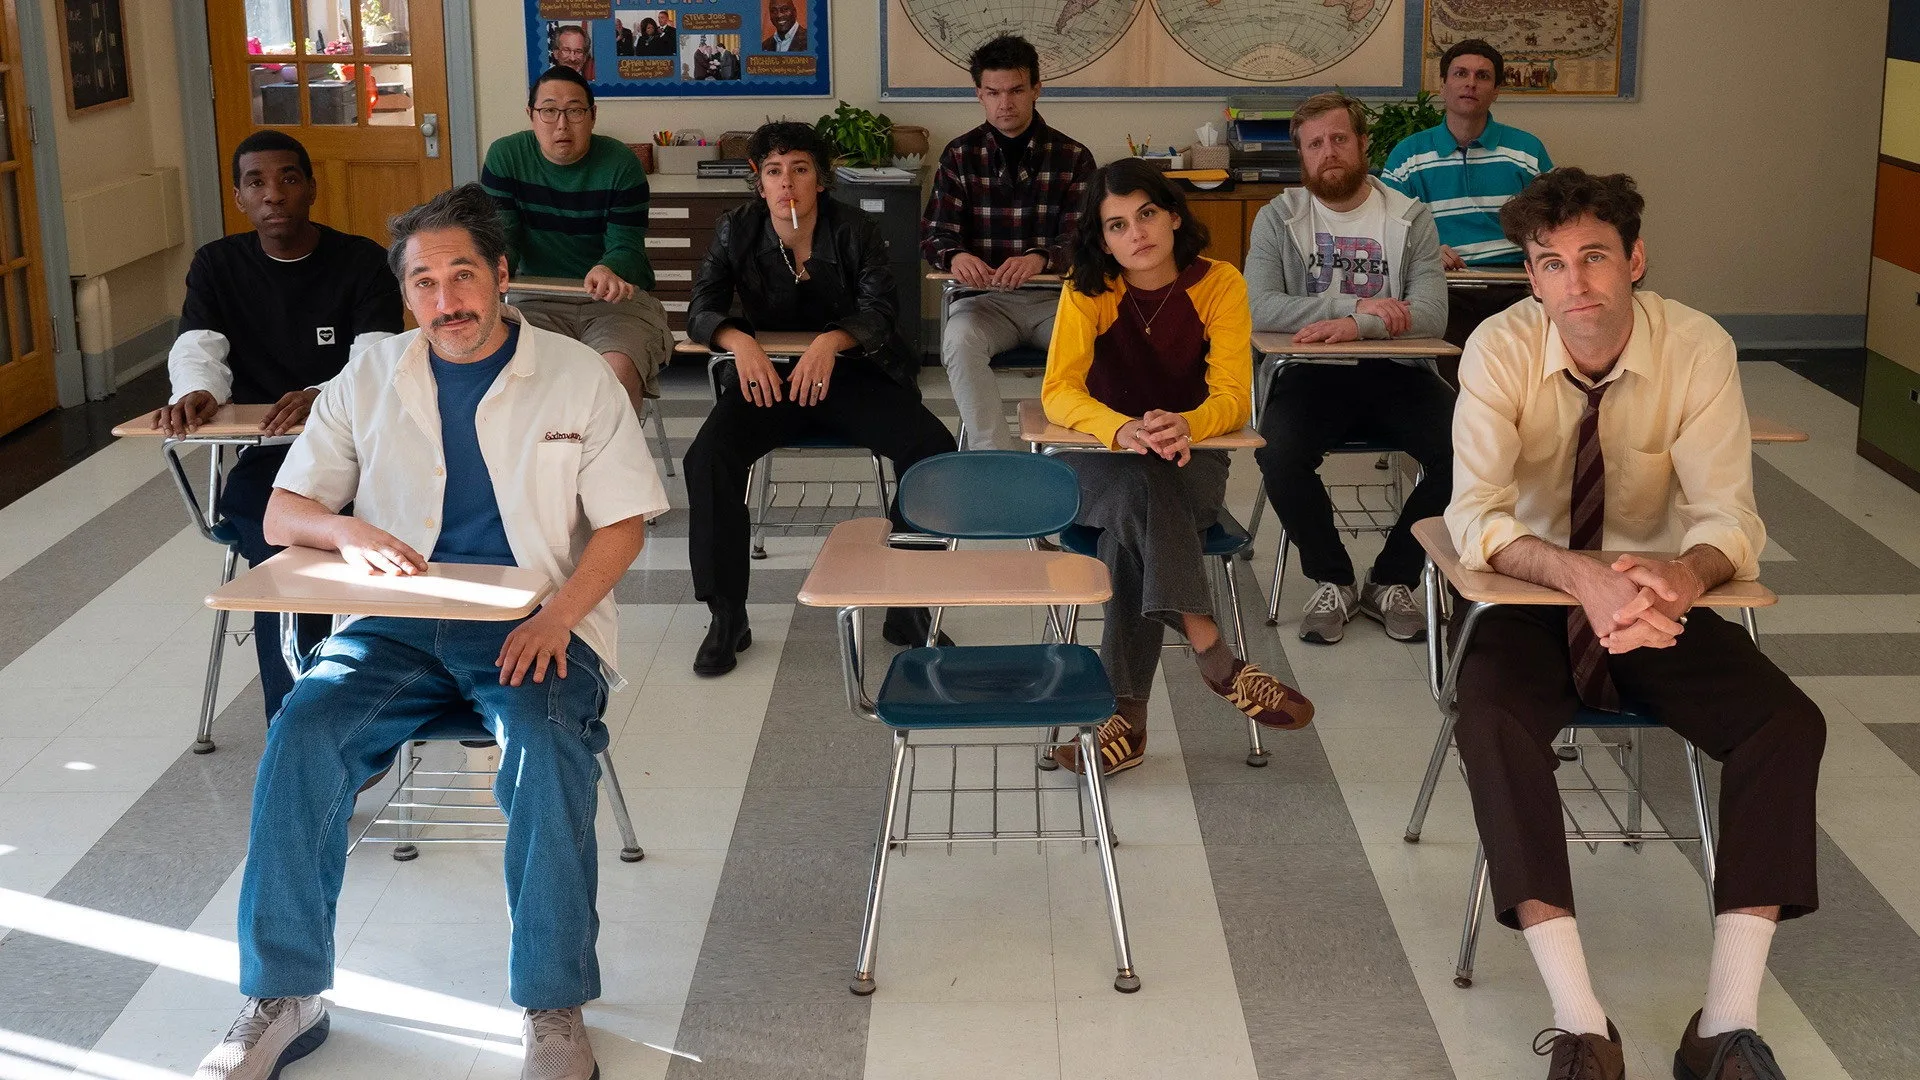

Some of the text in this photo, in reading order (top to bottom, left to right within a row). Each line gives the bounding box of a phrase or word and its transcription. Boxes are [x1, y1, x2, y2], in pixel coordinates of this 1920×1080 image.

[684, 13, 726, 21] STEVE JOBS
[781, 57, 809, 65] JORDAN
